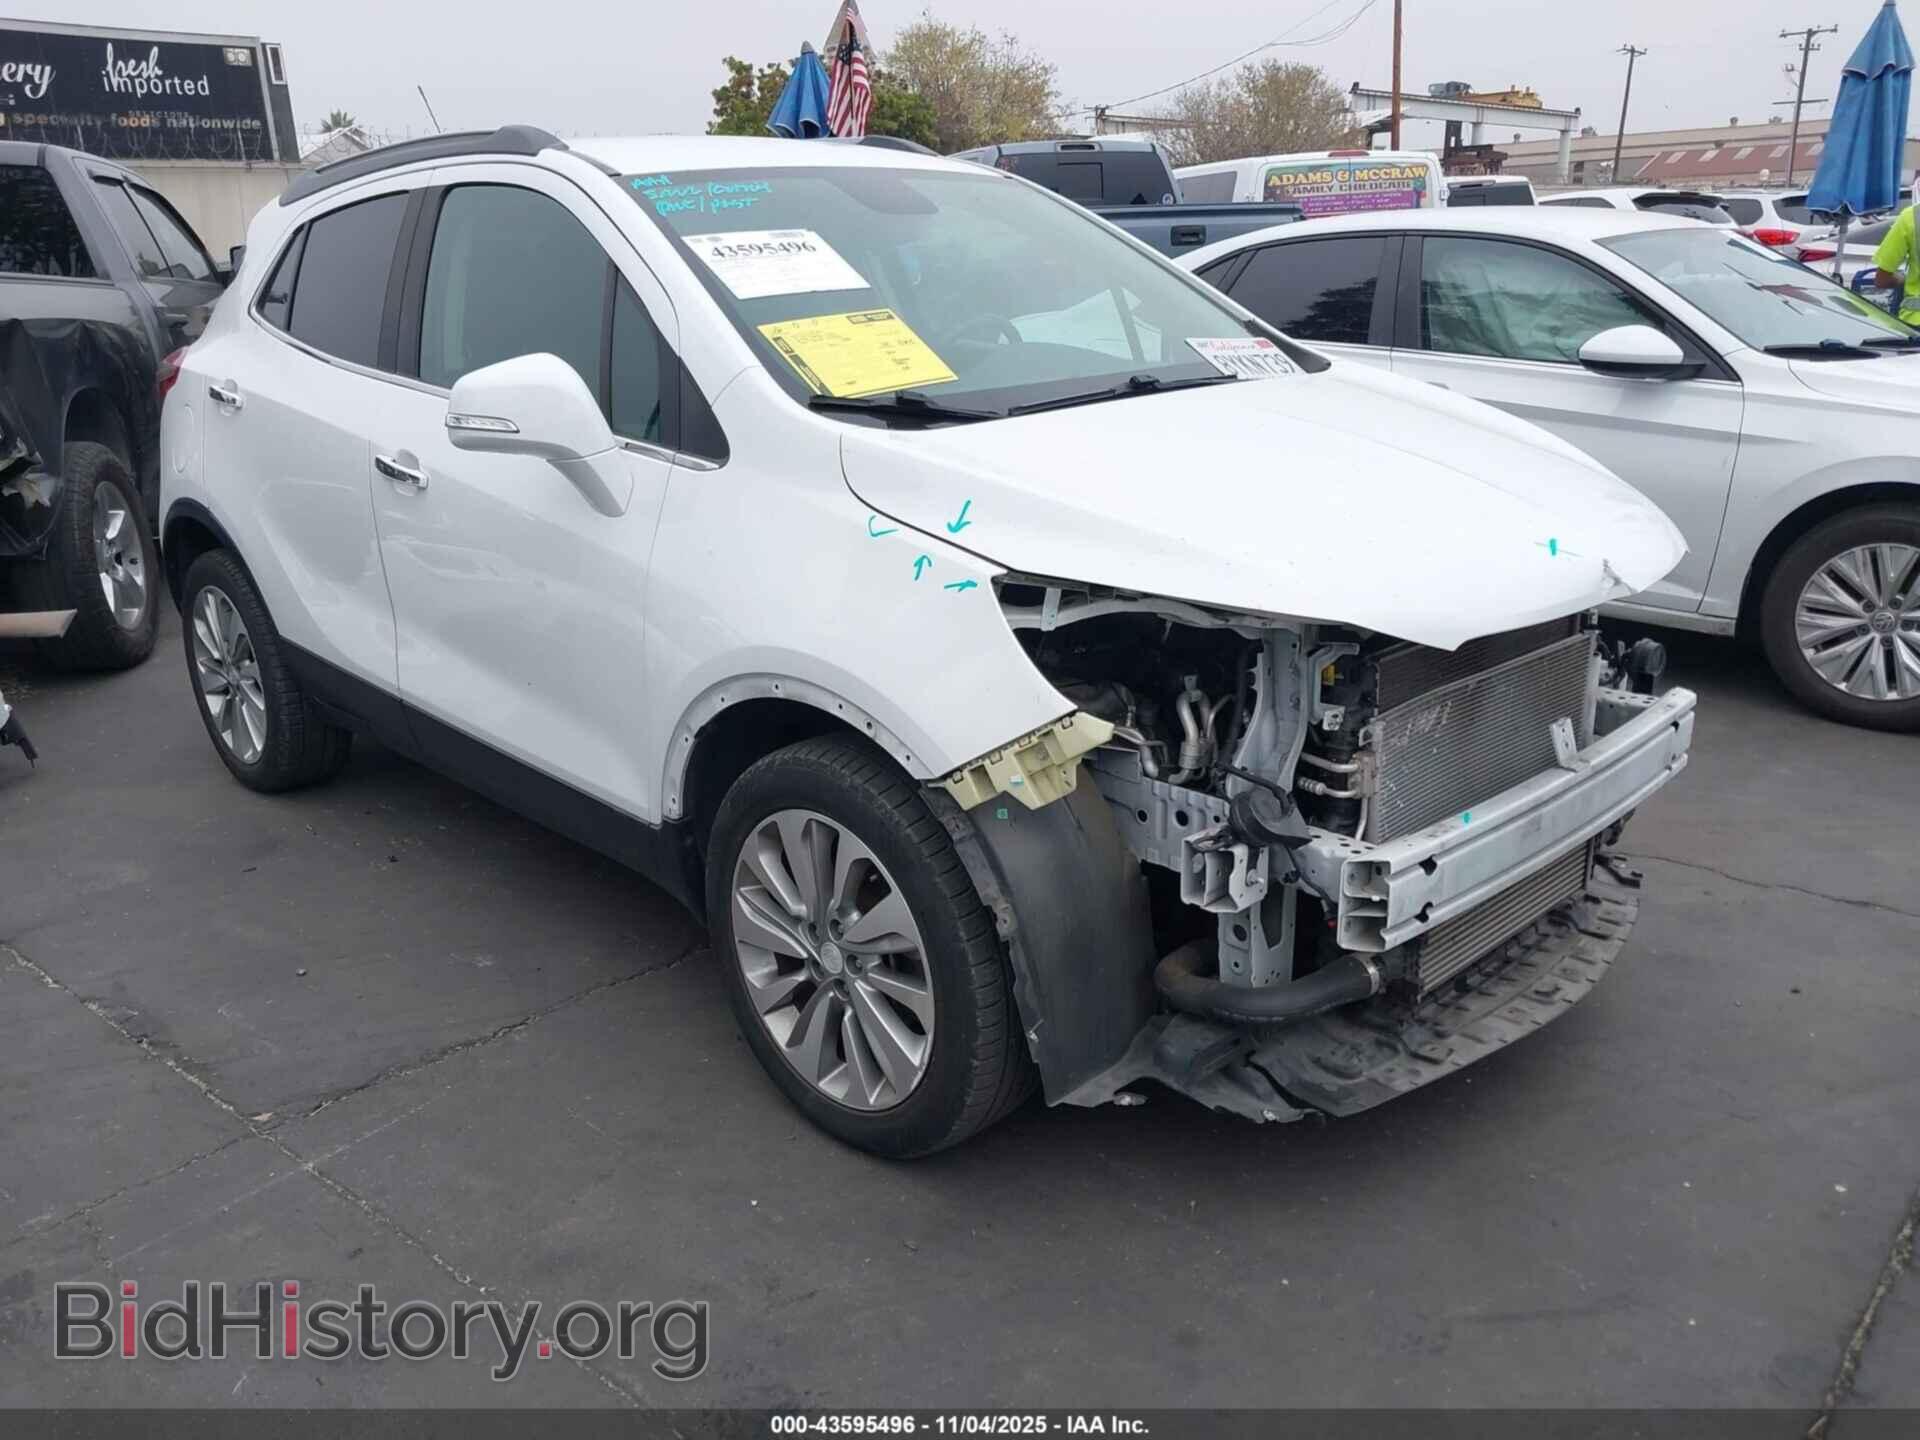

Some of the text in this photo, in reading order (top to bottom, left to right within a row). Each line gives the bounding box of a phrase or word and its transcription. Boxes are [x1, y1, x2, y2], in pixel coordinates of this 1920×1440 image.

[105, 42, 164, 80] fresh
[0, 61, 56, 99] ery
[102, 71, 210, 98] imported
[111, 112, 160, 129] foods
[166, 113, 262, 130] nationwide
[1268, 170, 1333, 187] ADAMS
[1355, 166, 1427, 180] MCCRAW
[1287, 181, 1410, 195] FAMILY CHILDCARE
[712, 239, 817, 259] 43595496
